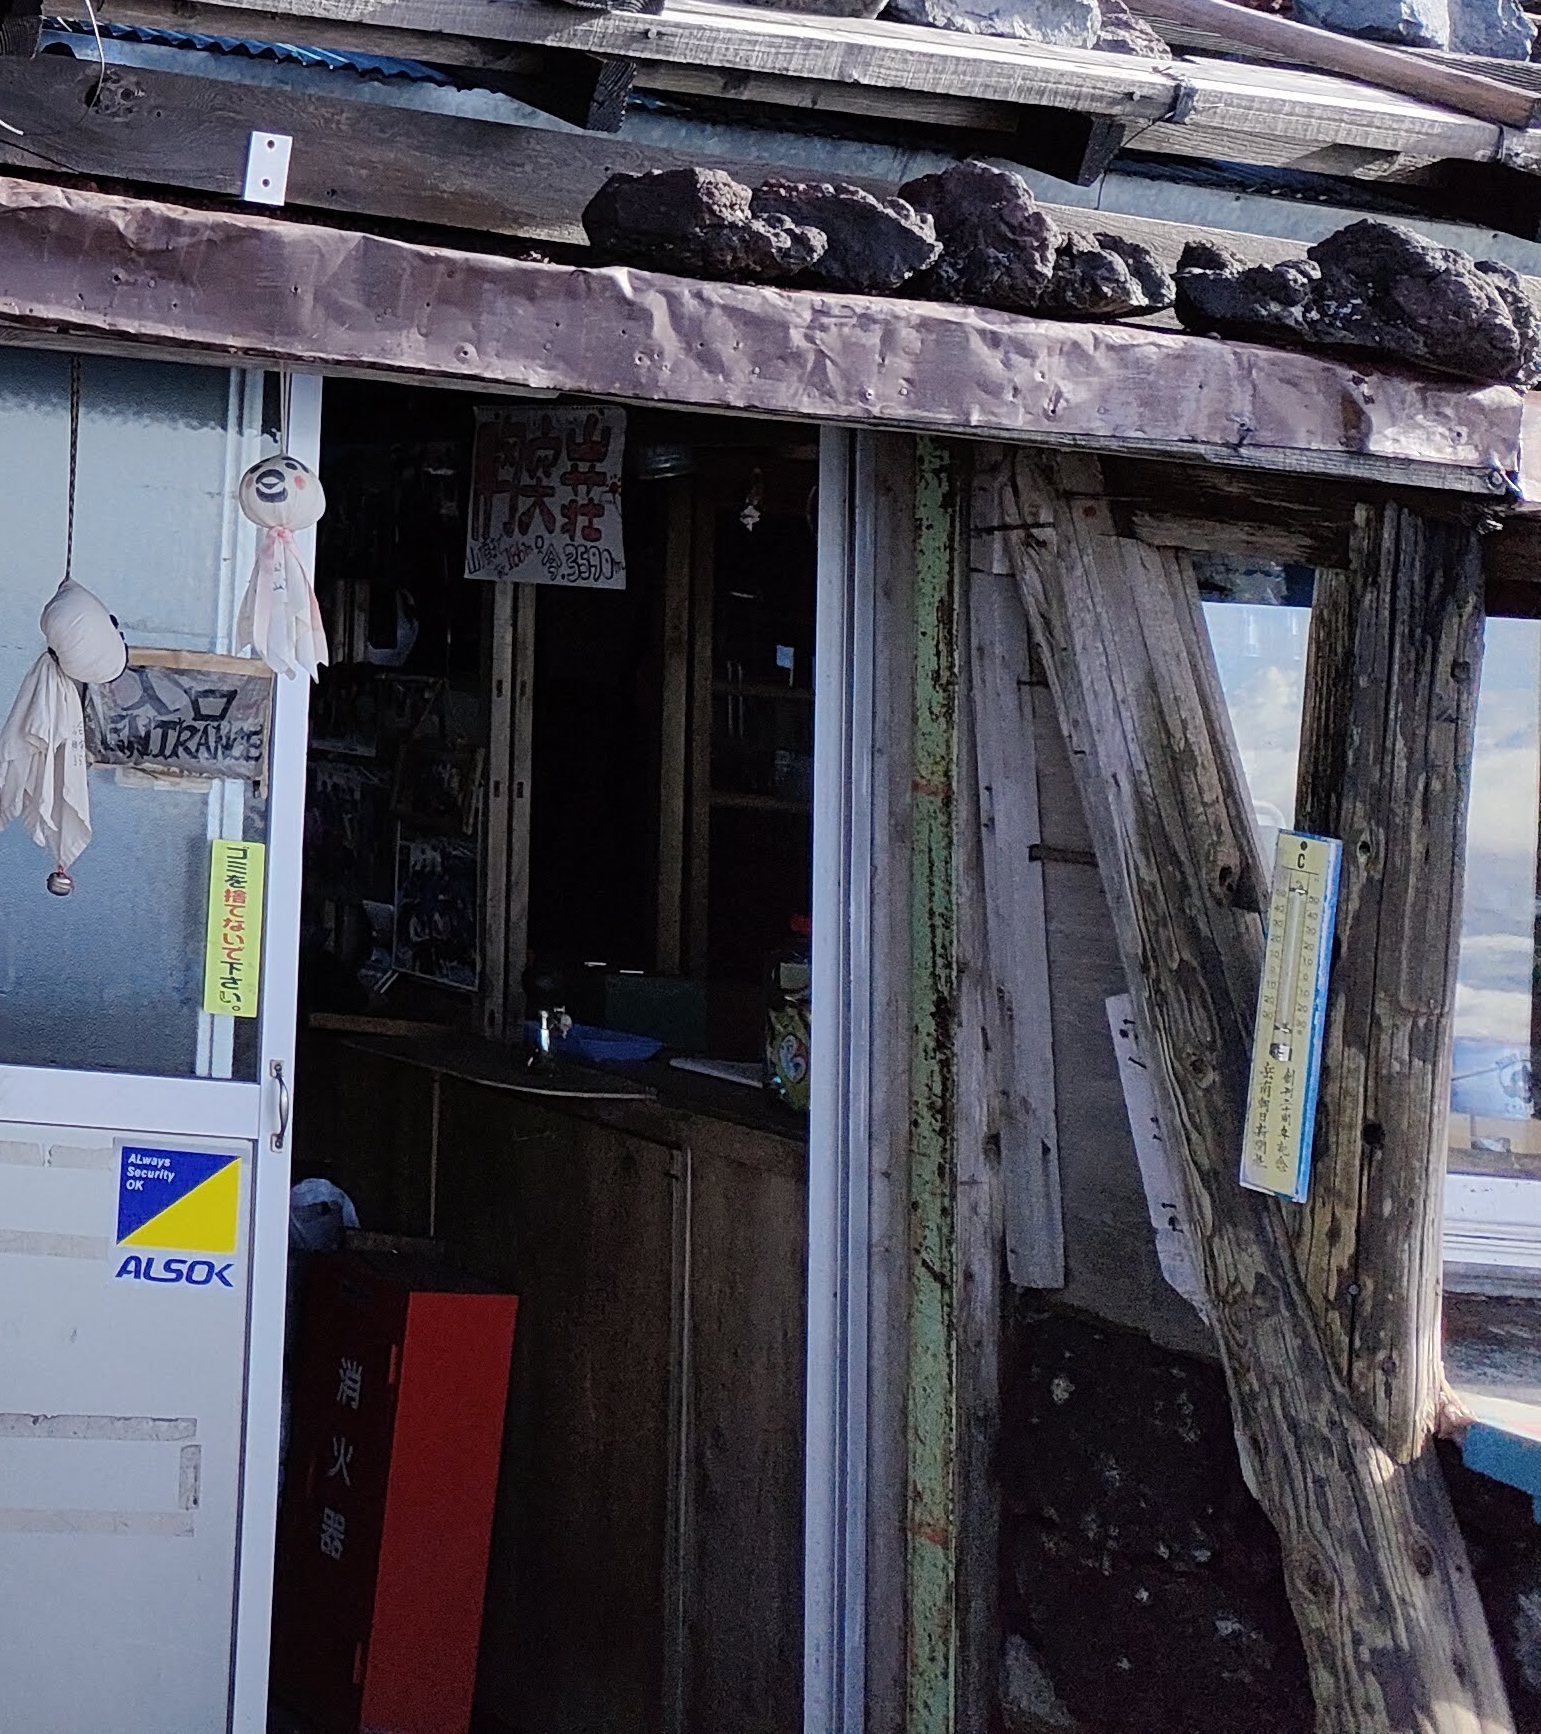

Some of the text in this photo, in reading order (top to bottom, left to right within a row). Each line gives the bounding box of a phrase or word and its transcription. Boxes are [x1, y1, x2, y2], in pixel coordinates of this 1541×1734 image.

[121, 668, 238, 722] 入口
[107, 713, 264, 763] ENTRANCE
[219, 845, 251, 1013] ゴミを捨てないで下さい。
[126, 1166, 176, 1184] Security
[127, 1153, 172, 1169] ALways
[125, 1180, 145, 1192] OK
[115, 1255, 235, 1288] ALSOK
[320, 1357, 364, 1562] 消火器
